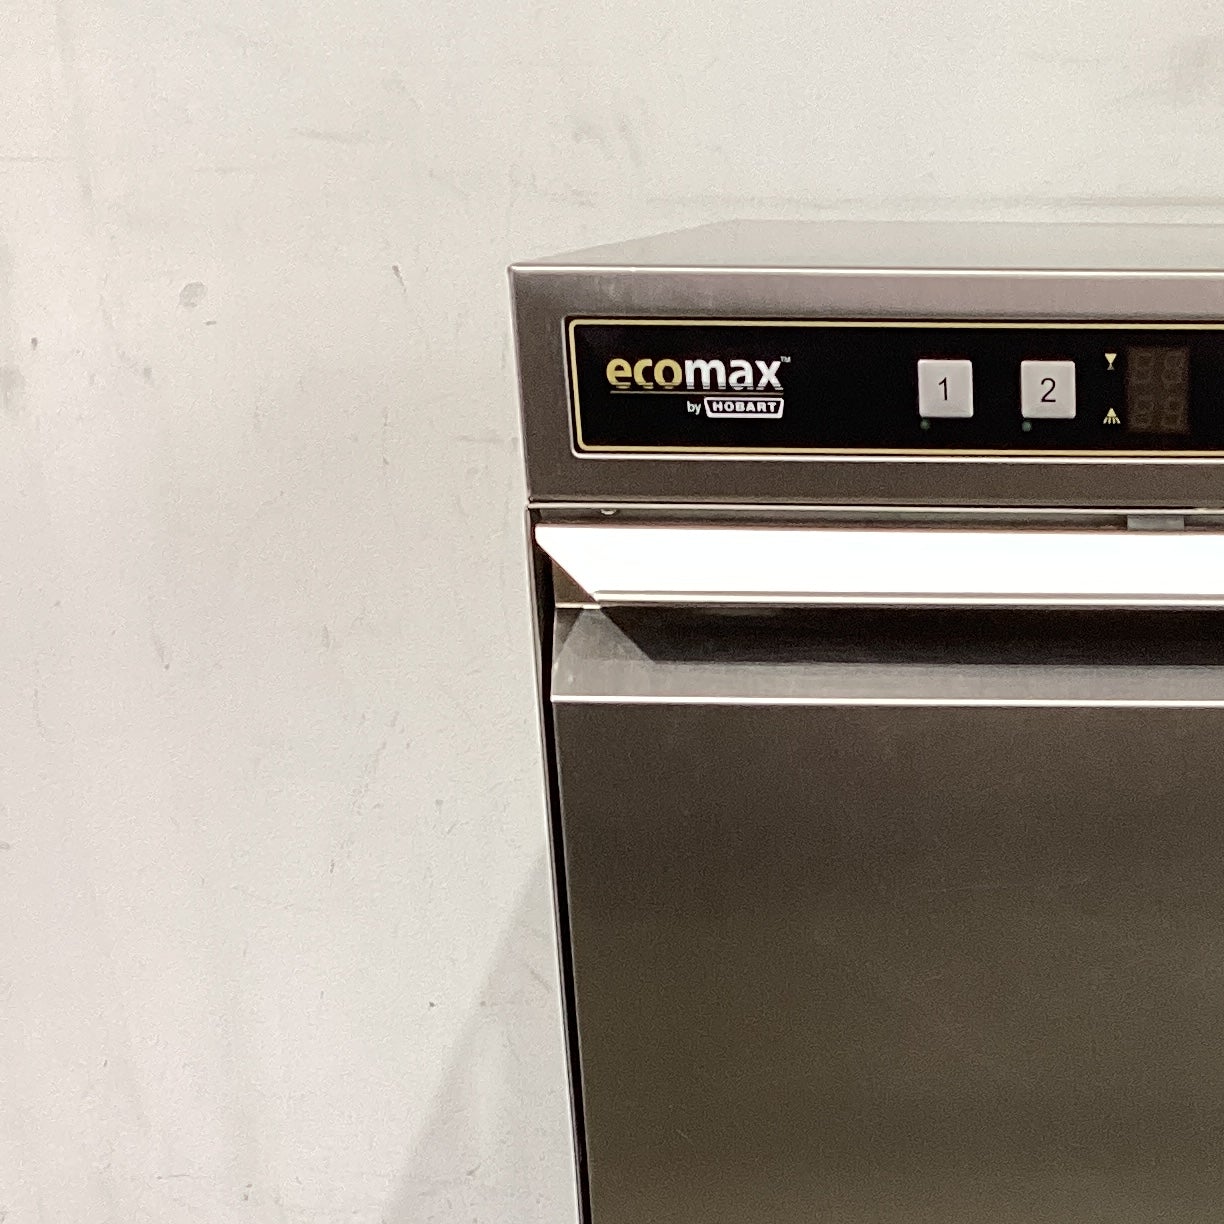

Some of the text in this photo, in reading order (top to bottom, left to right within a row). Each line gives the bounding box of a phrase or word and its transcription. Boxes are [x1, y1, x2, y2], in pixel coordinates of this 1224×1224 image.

[606, 358, 784, 391] ecomax
[937, 378, 949, 401] 1
[1040, 378, 1057, 403] 2
[687, 401, 777, 415] by HOBART
